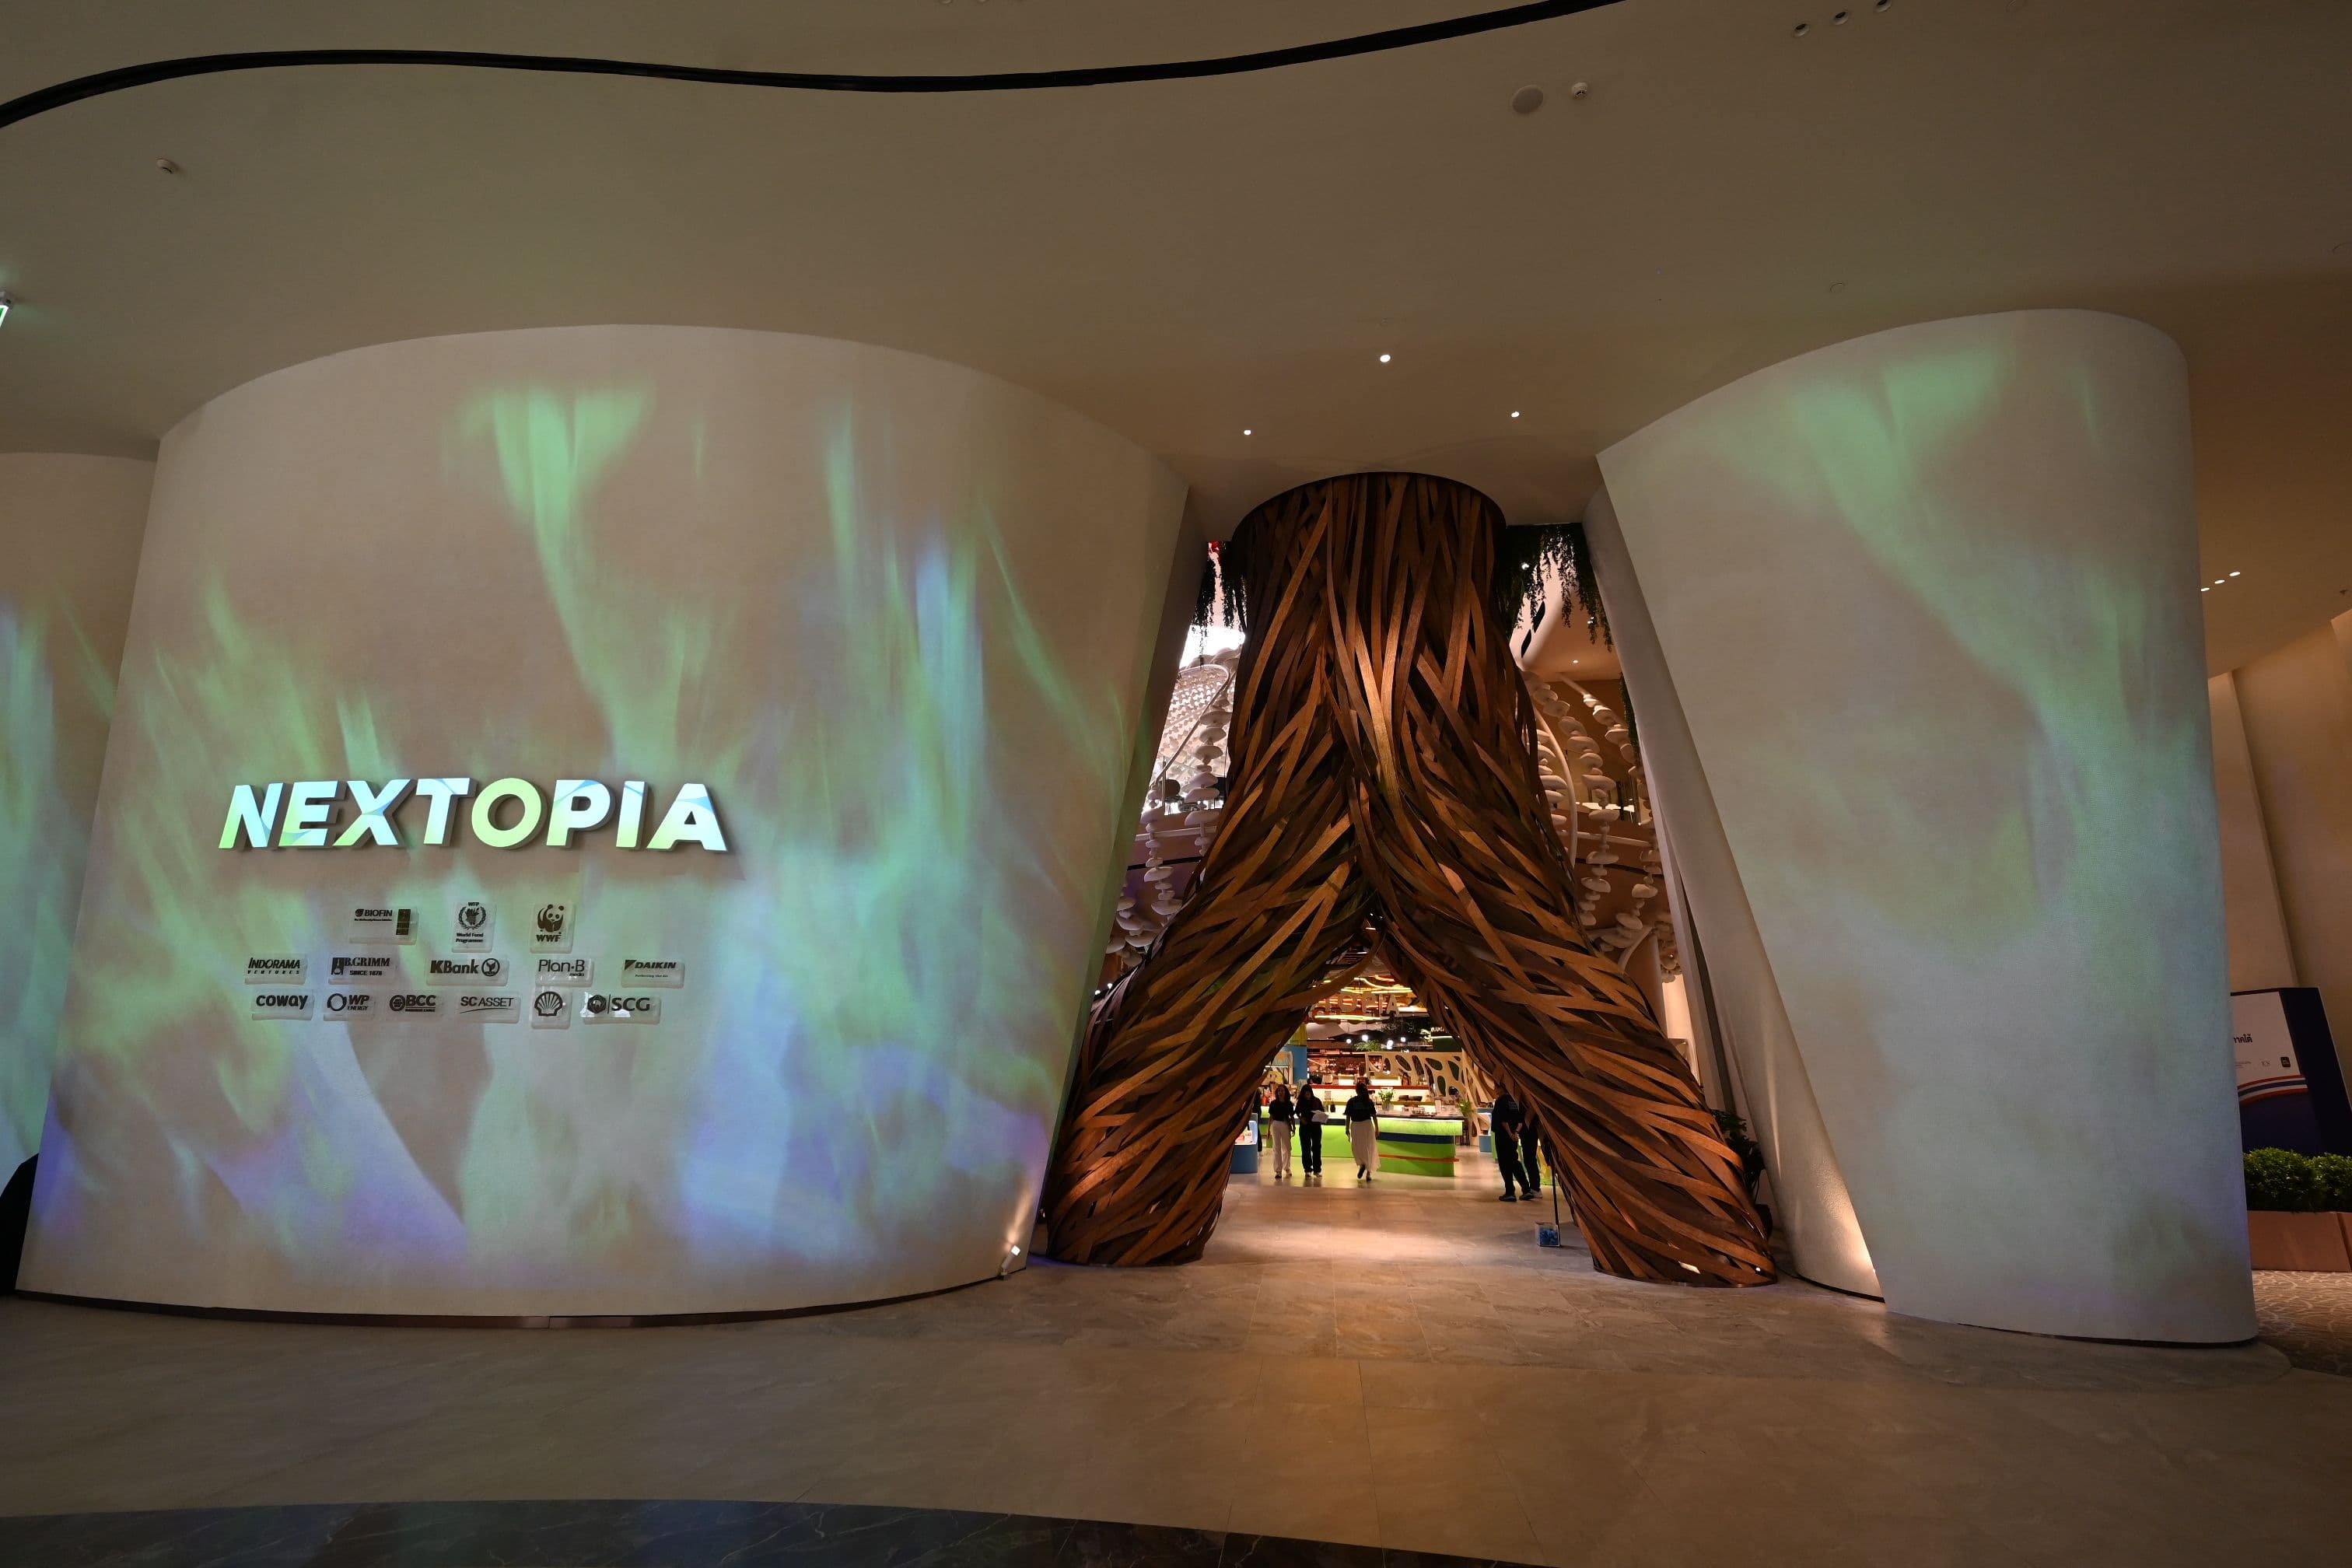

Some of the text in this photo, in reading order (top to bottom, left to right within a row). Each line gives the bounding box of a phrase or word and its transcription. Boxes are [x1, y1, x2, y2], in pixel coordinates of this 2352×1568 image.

[219, 777, 728, 852] NEXTOPIA
[536, 934, 562, 943] WWF
[248, 957, 300, 969] INDORAMA
[430, 958, 480, 974] KBank
[256, 995, 308, 1010] coway
[348, 995, 370, 1005] WP
[405, 995, 436, 1006] BCC
[611, 997, 650, 1011] SCG
